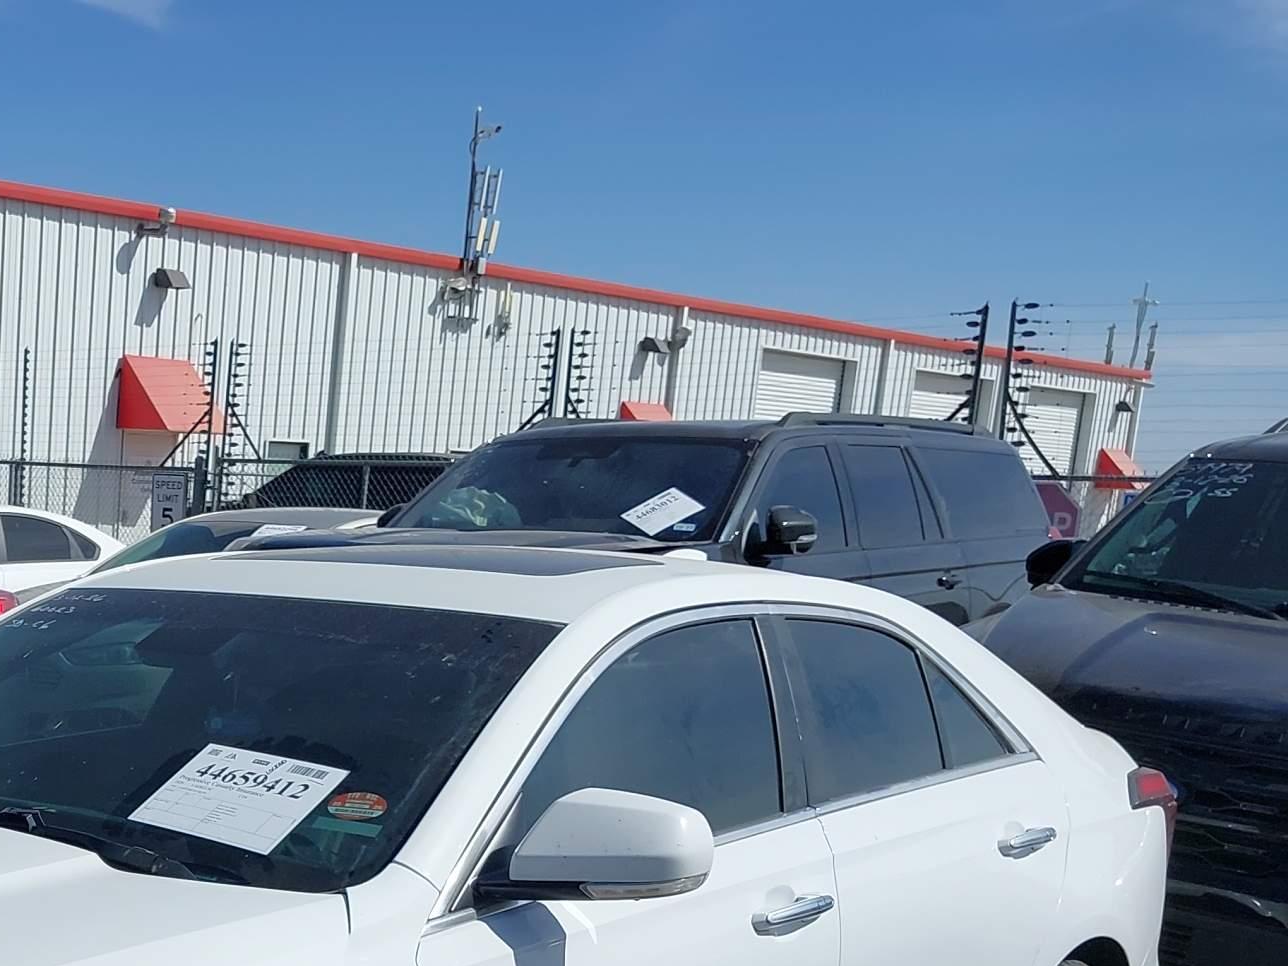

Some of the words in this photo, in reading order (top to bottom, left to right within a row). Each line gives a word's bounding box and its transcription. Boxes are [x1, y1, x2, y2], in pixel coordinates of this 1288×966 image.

[155, 480, 183, 490] SPEED
[157, 494, 180, 503] LIMIT
[161, 507, 174, 527] 5
[195, 763, 311, 800] 44659412
